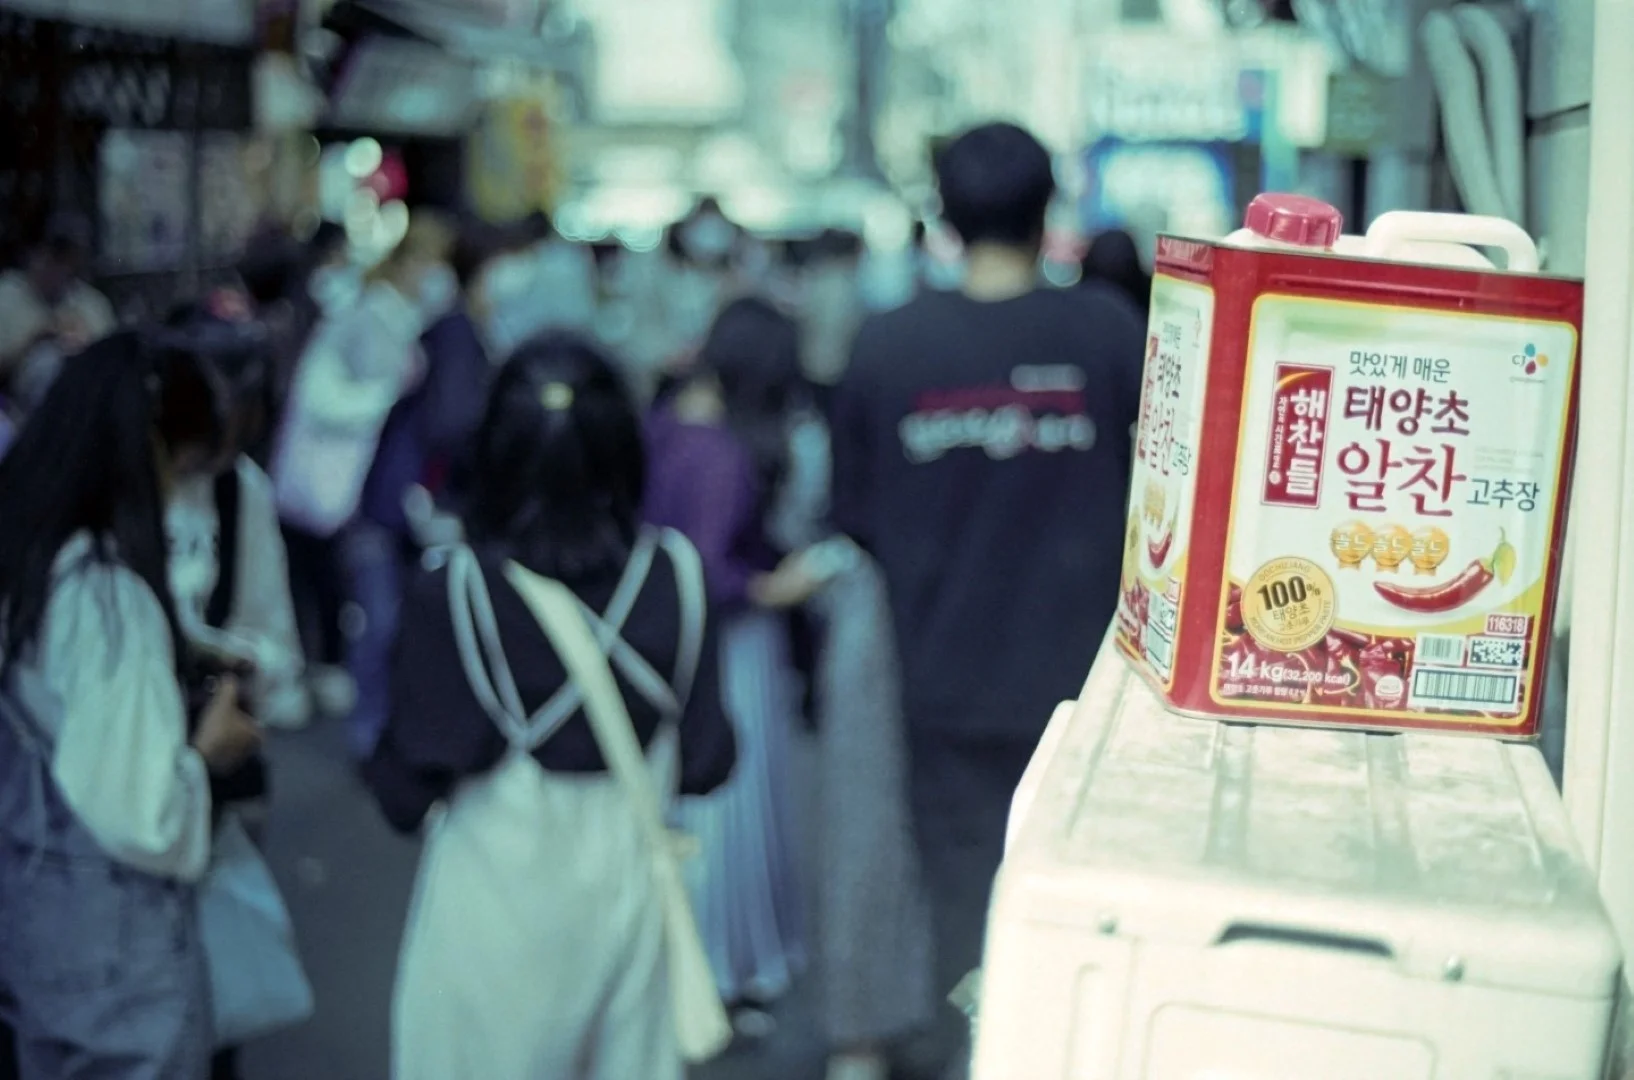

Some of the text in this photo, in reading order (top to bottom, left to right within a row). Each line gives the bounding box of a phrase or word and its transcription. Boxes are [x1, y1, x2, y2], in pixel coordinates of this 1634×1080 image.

[1350, 351, 1451, 383] 맛있게 매운
[1343, 385, 1470, 436] 태양초
[1286, 388, 1327, 496] 해찬들
[1336, 438, 1467, 517] 알찬
[1466, 478, 1540, 512] 고추장
[1257, 575, 1321, 611] 100%
[1228, 652, 1255, 678] 14
